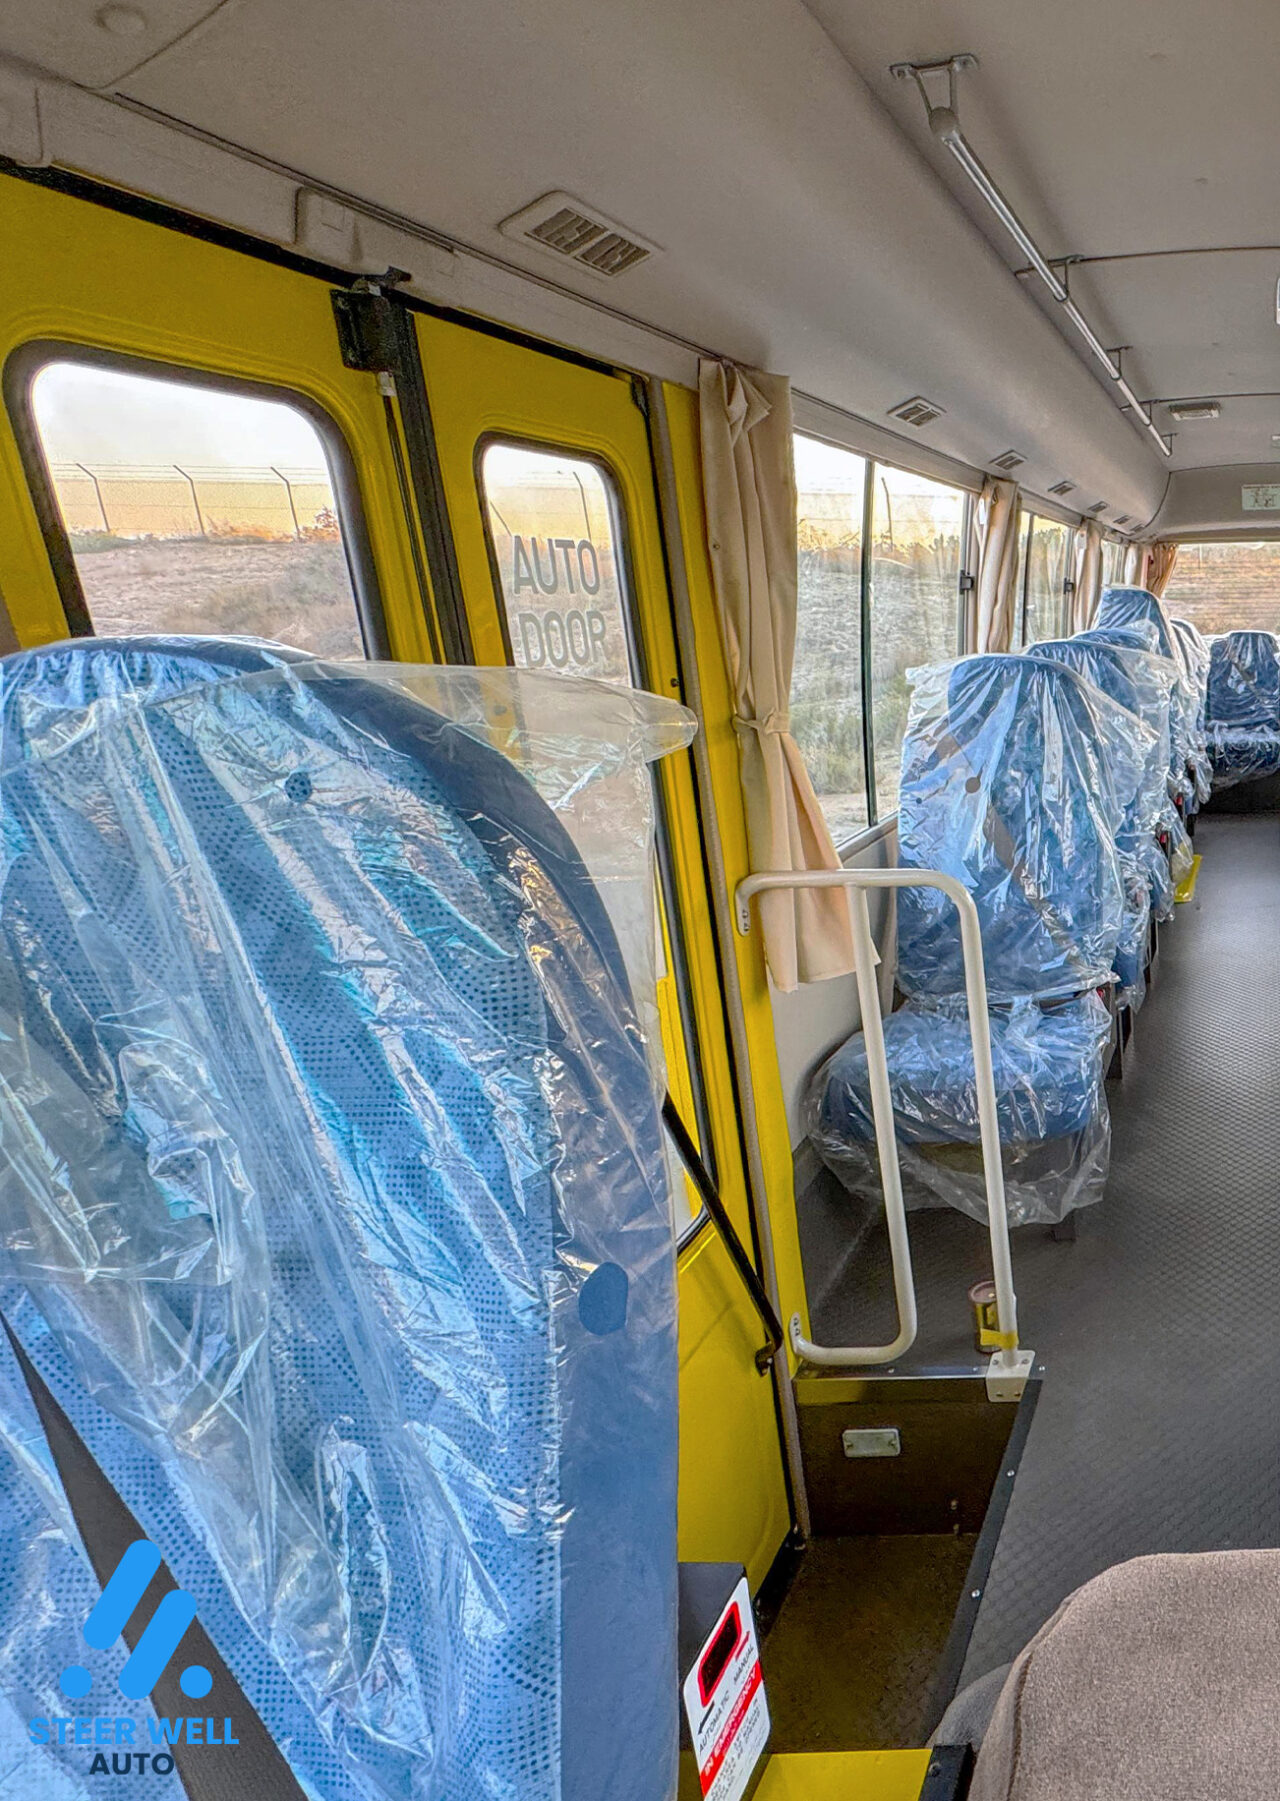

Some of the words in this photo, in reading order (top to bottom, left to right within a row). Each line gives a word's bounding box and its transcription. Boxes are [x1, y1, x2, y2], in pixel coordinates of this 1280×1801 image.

[514, 535, 600, 595] AUTO
[518, 610, 606, 667] DOOR
[734, 1645, 754, 1684] MANUAL
[700, 1690, 729, 1755] AUTOMATIC
[704, 1757, 714, 1776] IN
[714, 1666, 755, 1757] EMERGENCY
